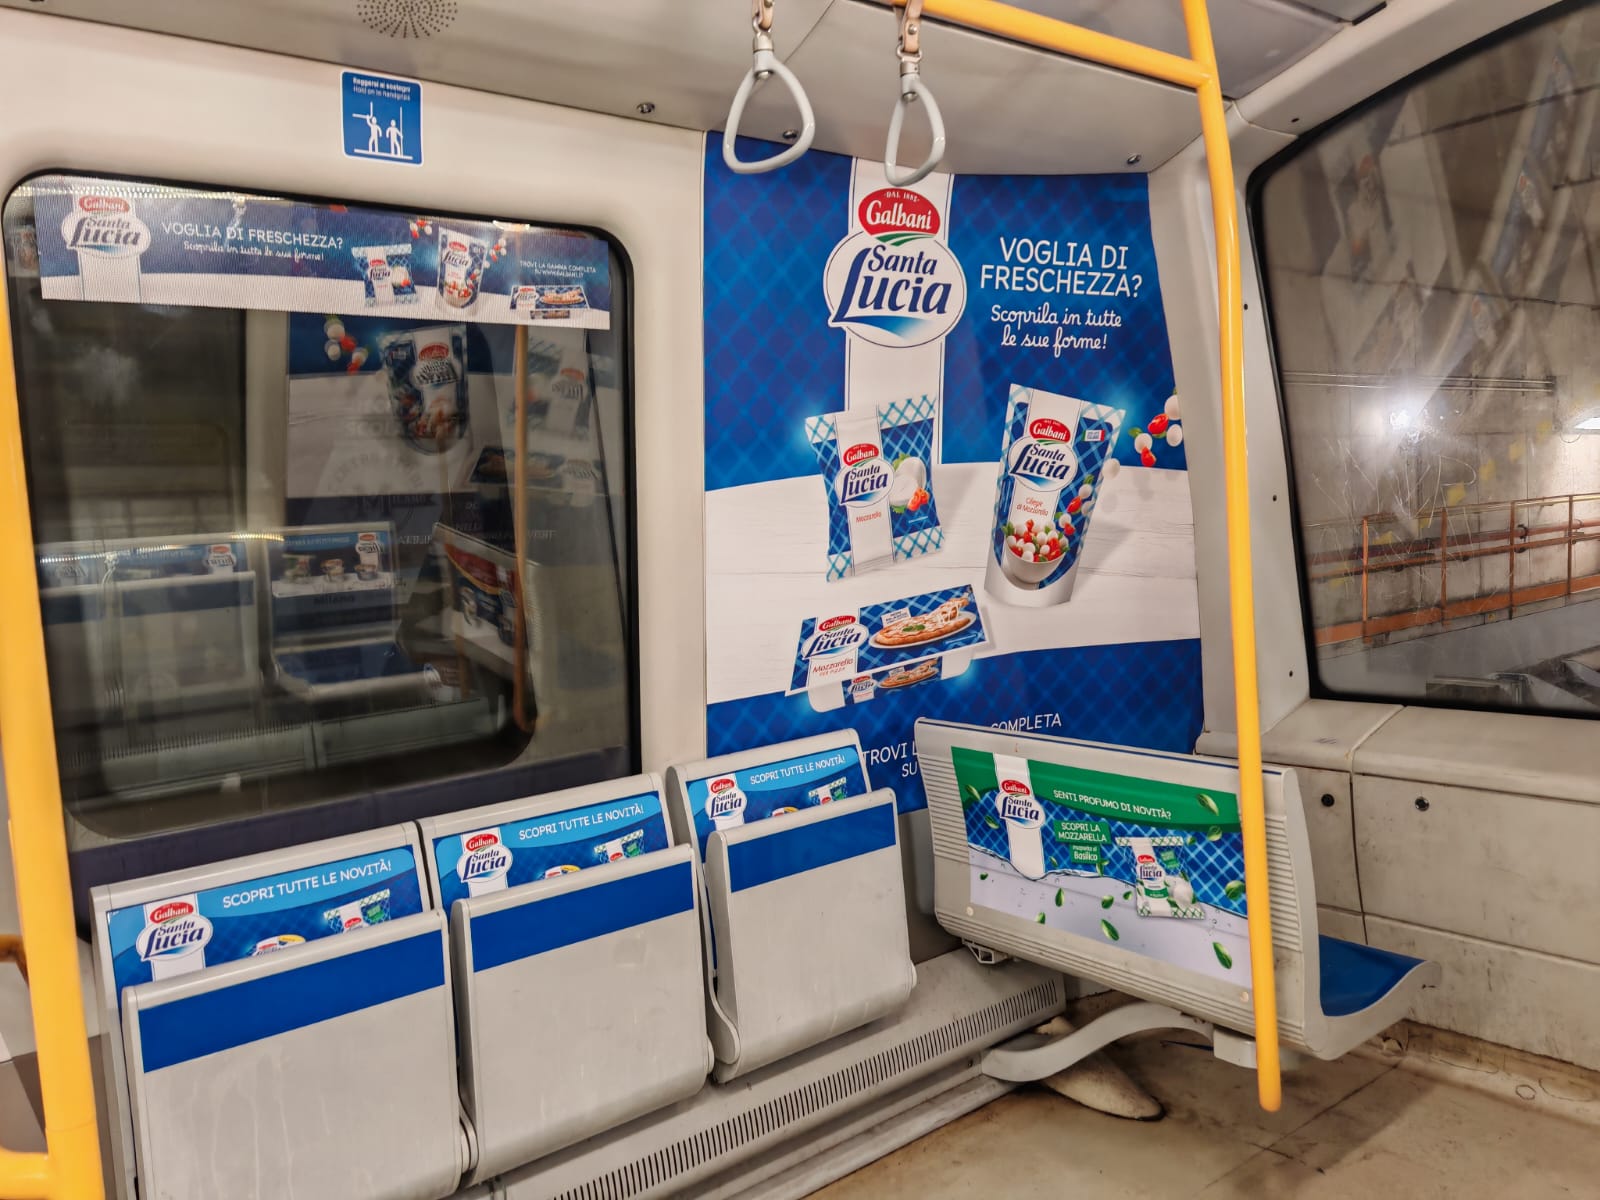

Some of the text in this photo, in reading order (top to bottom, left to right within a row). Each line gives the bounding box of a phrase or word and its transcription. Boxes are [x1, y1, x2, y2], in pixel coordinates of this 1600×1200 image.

[866, 200, 931, 230] Galbani
[161, 222, 343, 249] VOGLIA DI FRESCHEZZA?
[868, 245, 937, 275] Santa
[1000, 237, 1128, 269] VOGLIA DI
[832, 247, 952, 322] Lucia
[980, 264, 1142, 297] FRESCHEZZA?
[991, 302, 1122, 330] Scoprila in tutte
[1001, 324, 1107, 358] le sue forme!
[1032, 423, 1068, 441] Galbani
[846, 447, 875, 461] Galbani
[1010, 443, 1070, 480] Lucia
[1030, 443, 1065, 463] Santa
[850, 464, 881, 480] Santa
[841, 470, 888, 504] Lucia
[805, 632, 861, 658] Lucia
[821, 628, 854, 640] Santa
[862, 742, 907, 765] TROVI
[750, 754, 845, 785] SCOPRI TUTTE LE NOVITÀ!
[902, 761, 918, 777] SU
[1004, 782, 1028, 794] Galbani
[1000, 796, 1040, 820] Lucia
[1008, 795, 1033, 808] Santa
[1053, 789, 1172, 820] SENTI PROFUMO DI NOVITÀ?
[519, 803, 644, 840] SCOPRI TUTTE LE NOVITÀ!
[1061, 822, 1101, 832] SCOPRI LA
[468, 836, 495, 849] Galbani
[1058, 831, 1107, 842] MOZZARELLA
[472, 848, 499, 862] Santa
[1074, 850, 1098, 861] Basilico
[463, 855, 506, 880] Lucia
[223, 859, 392, 909] SCOPRI TUTTE LE NOVITÀ!
[154, 905, 189, 921] Galbani
[158, 921, 194, 937] Santa
[144, 927, 204, 959] Lucia
